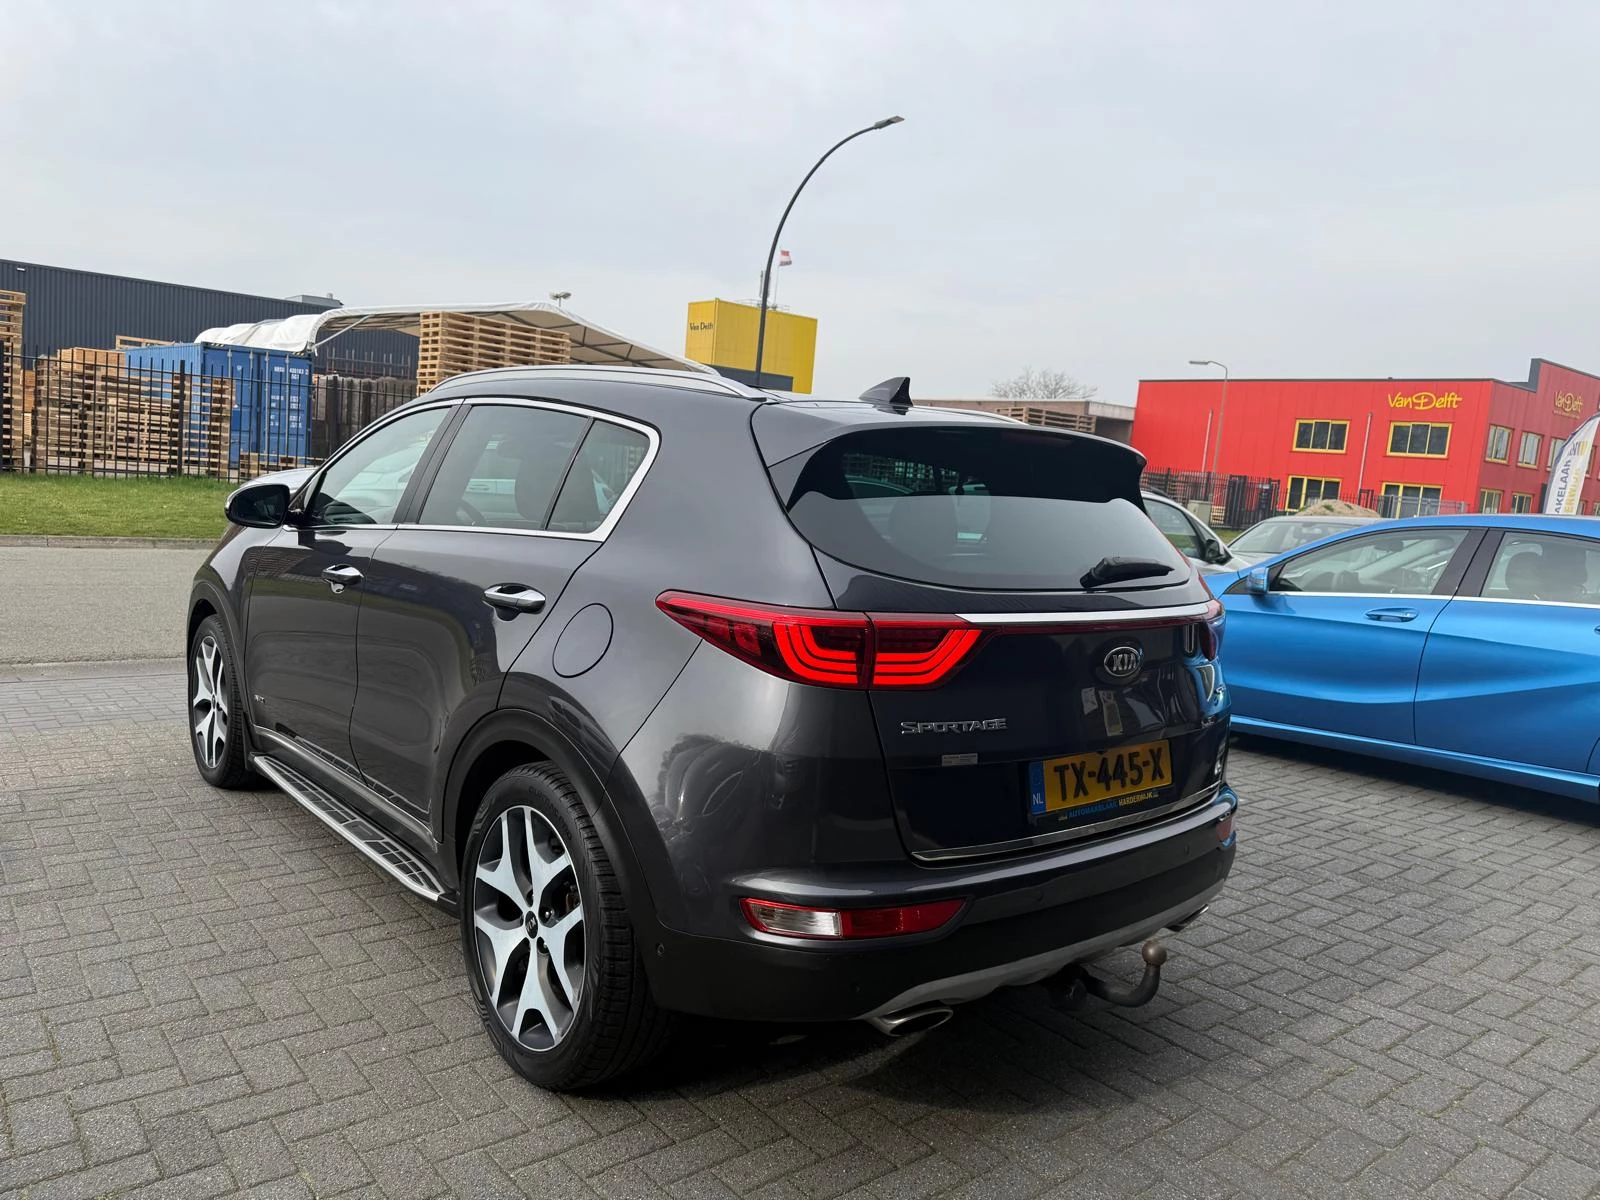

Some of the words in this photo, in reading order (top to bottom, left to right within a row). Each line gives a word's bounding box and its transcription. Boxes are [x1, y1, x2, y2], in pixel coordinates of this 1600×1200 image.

[900, 717, 1008, 735] SPORTAGE
[1053, 747, 1165, 802] TX-445-X
[1032, 792, 1044, 806] NL
